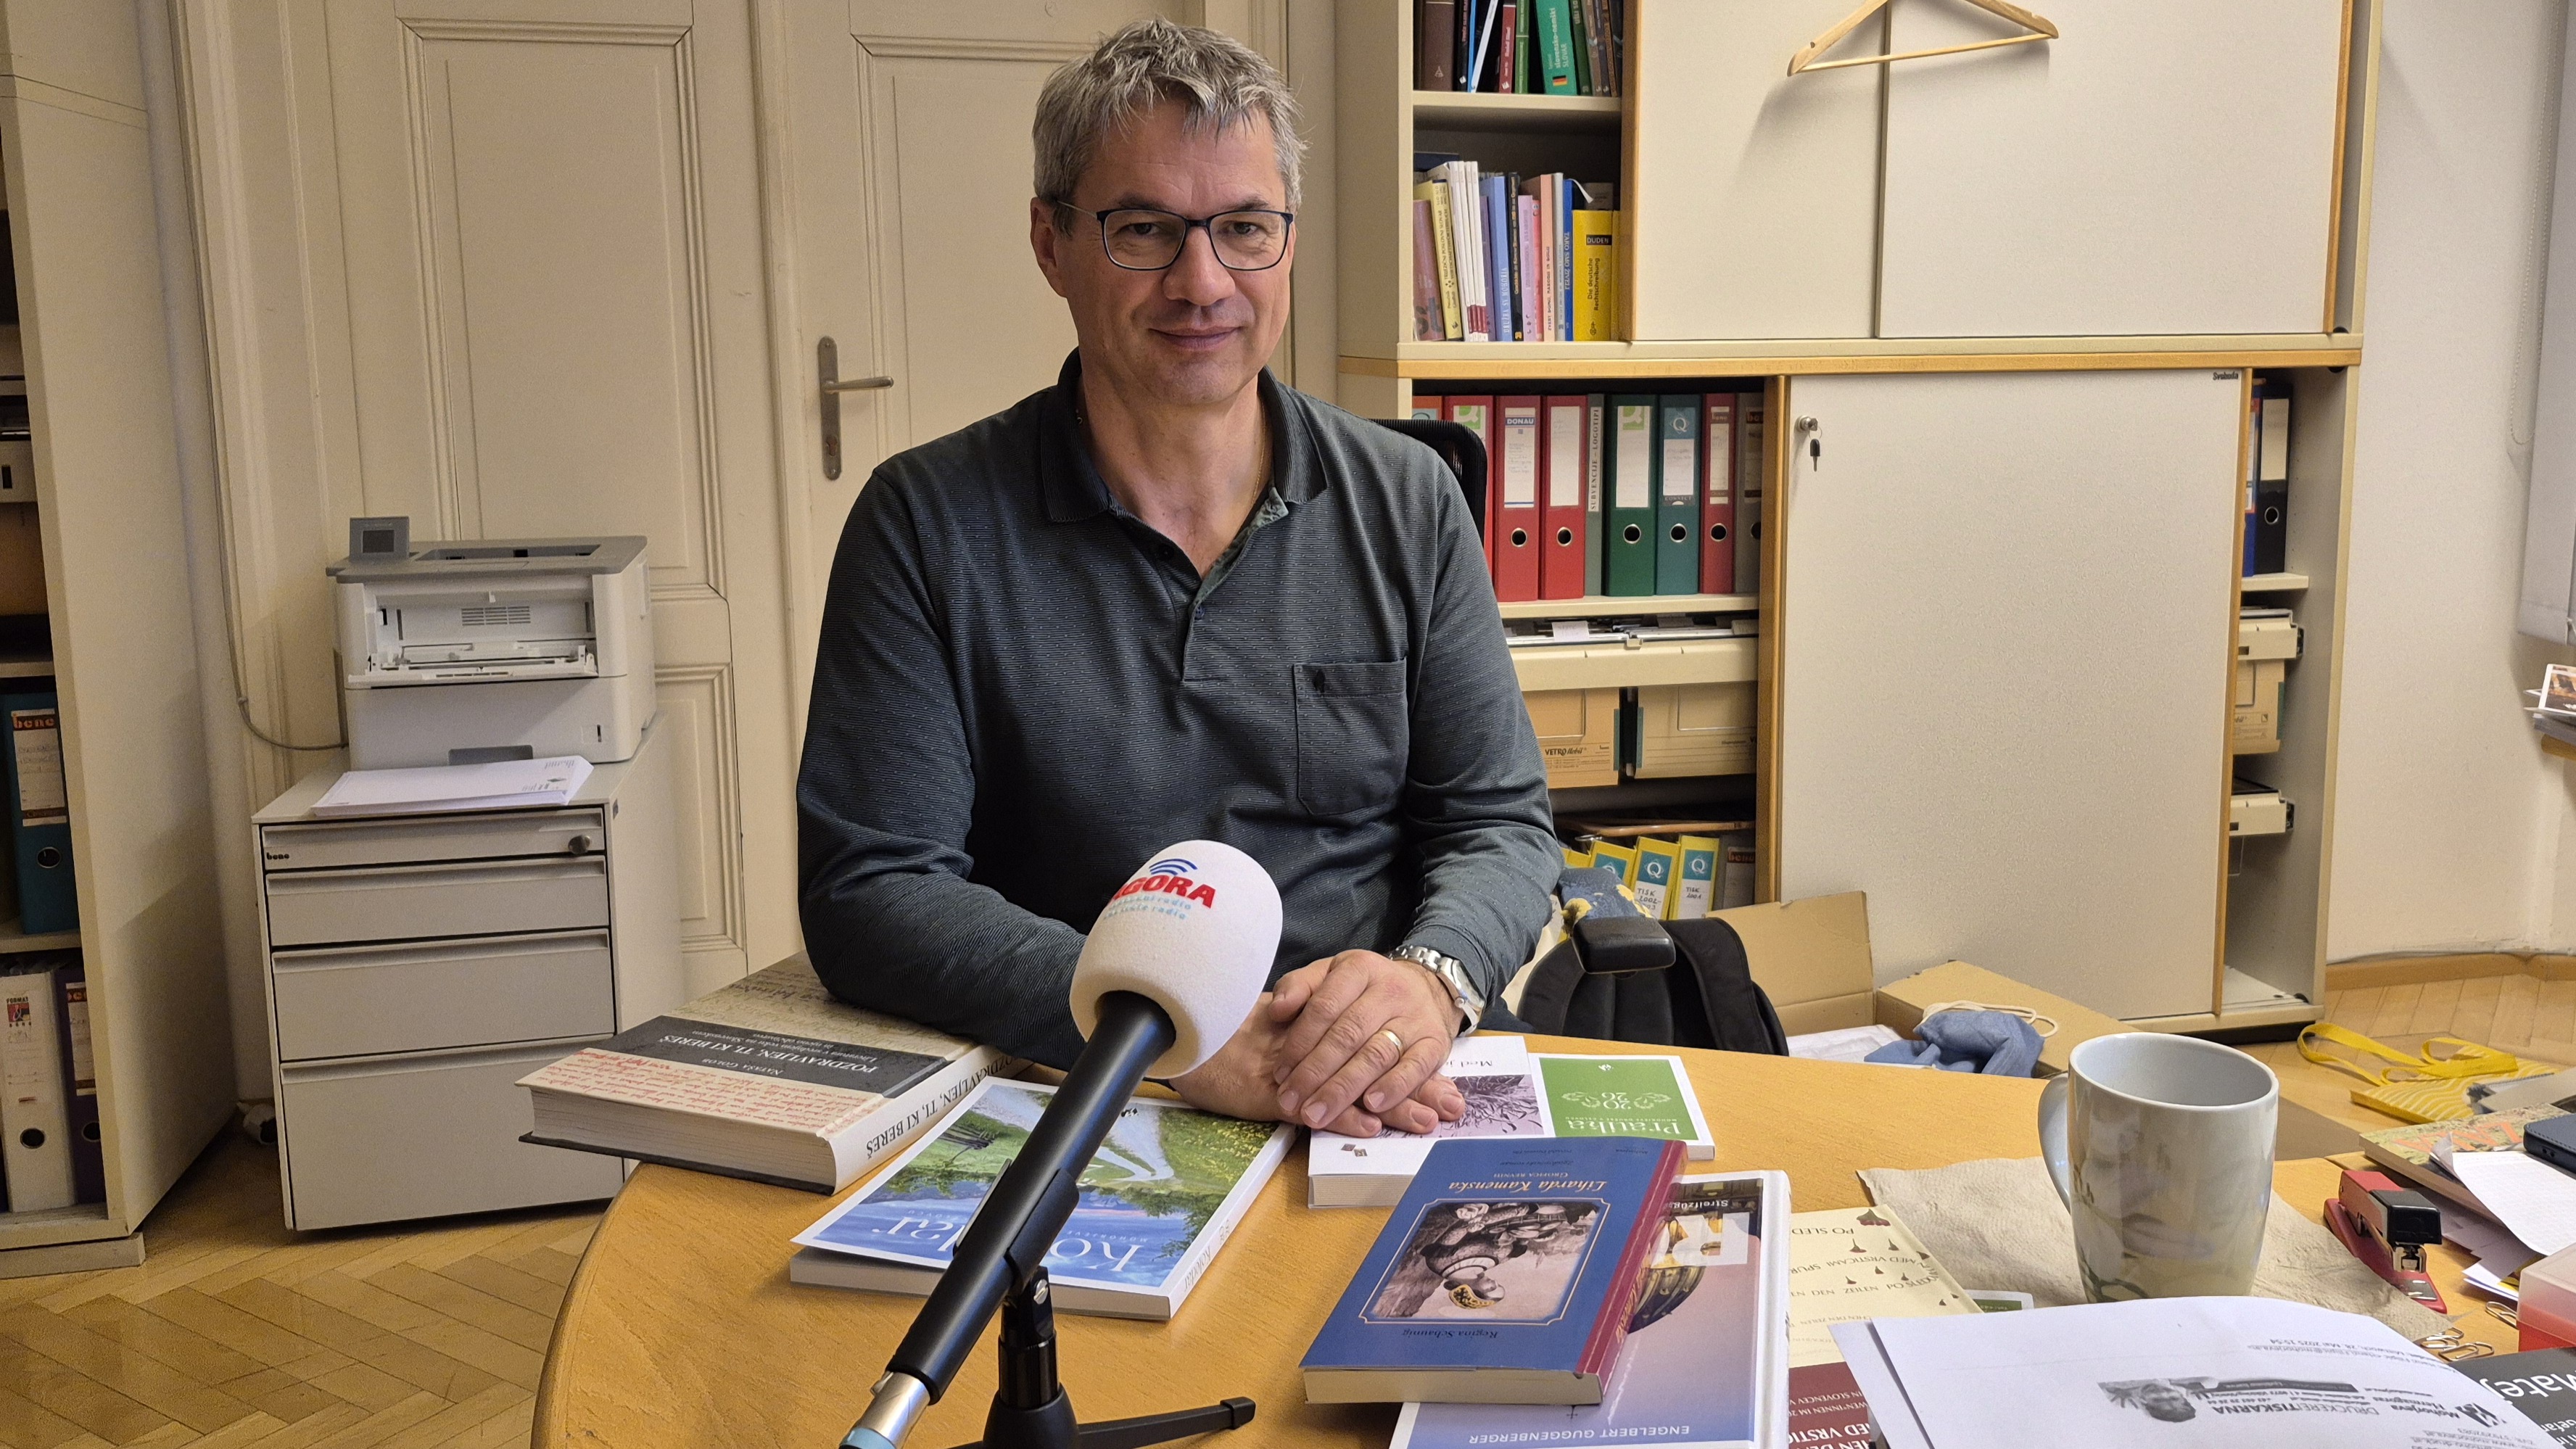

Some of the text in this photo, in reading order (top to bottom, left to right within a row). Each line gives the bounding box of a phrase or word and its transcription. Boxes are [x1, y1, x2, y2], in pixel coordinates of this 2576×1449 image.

[13, 713, 56, 730] bene
[266, 851, 289, 860] bene
[1637, 888, 1656, 896] TISK
[1157, 896, 1192, 910] radio
[1152, 906, 1187, 920] radio
[657, 1034, 878, 1074] POZDRAVLJEN, TI, KI BEREŠ
[1601, 1092, 1627, 1102] 26
[922, 1099, 938, 1114] TI,
[1603, 1100, 1631, 1110] 20
[907, 1110, 920, 1125] KI
[1568, 1119, 1682, 1135] Pratika
[866, 1120, 904, 1160] BEREŠ
[1448, 1180, 1608, 1194] Liharda Kamenska
[1825, 1255, 1887, 1267] VRSTICAMI
[1844, 1285, 1878, 1294] ZEILEN
[1401, 1327, 1498, 1339] Regina Schaunig
[1798, 1392, 1851, 1405] SLOVENCEV
[2390, 1404, 2460, 1419] Mohorjeva
[1469, 1425, 1690, 1444] ENGELBERT GUGGENBERGER
